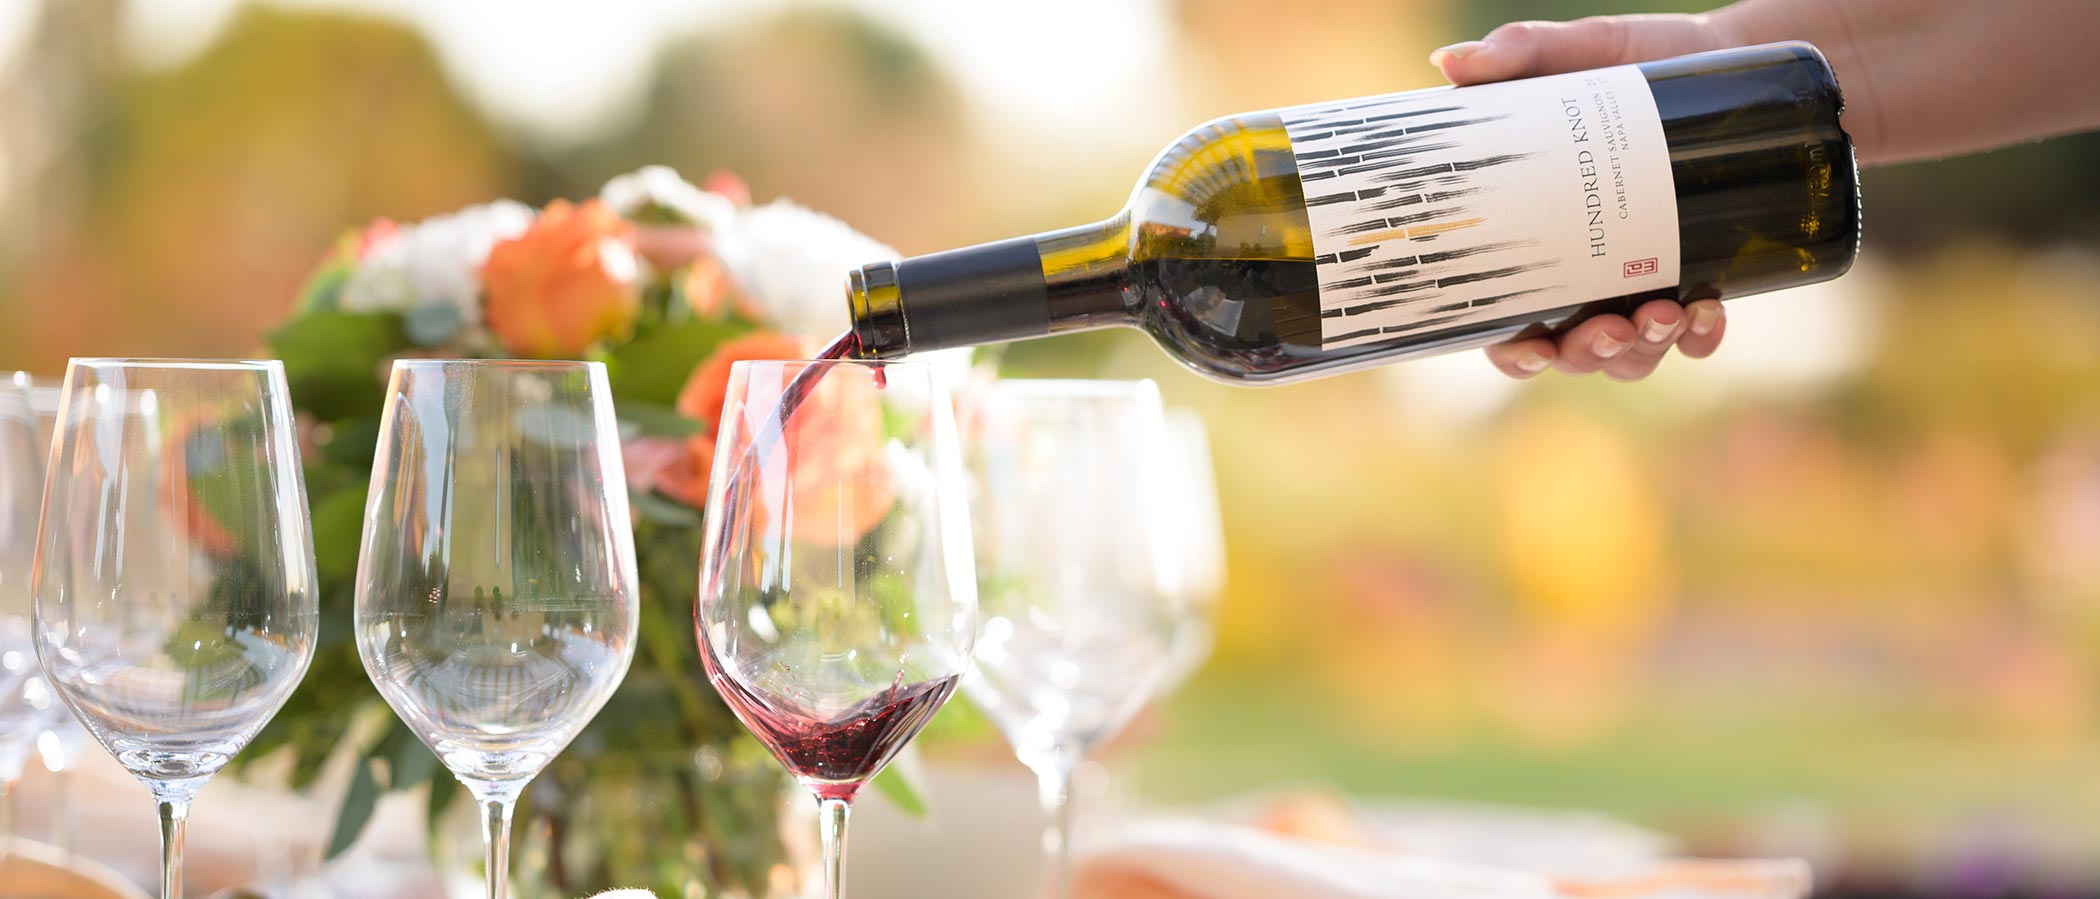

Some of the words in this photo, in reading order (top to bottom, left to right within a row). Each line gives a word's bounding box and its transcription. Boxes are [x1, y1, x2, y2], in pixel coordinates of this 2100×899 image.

[1561, 97, 1589, 143] KNOT
[1592, 93, 1617, 152] SAUVIGNON
[1607, 91, 1624, 122] VALLEY
[1617, 124, 1630, 151] NAPA
[1578, 150, 1606, 258] HUNDRED
[1610, 156, 1628, 219] CABERNET
